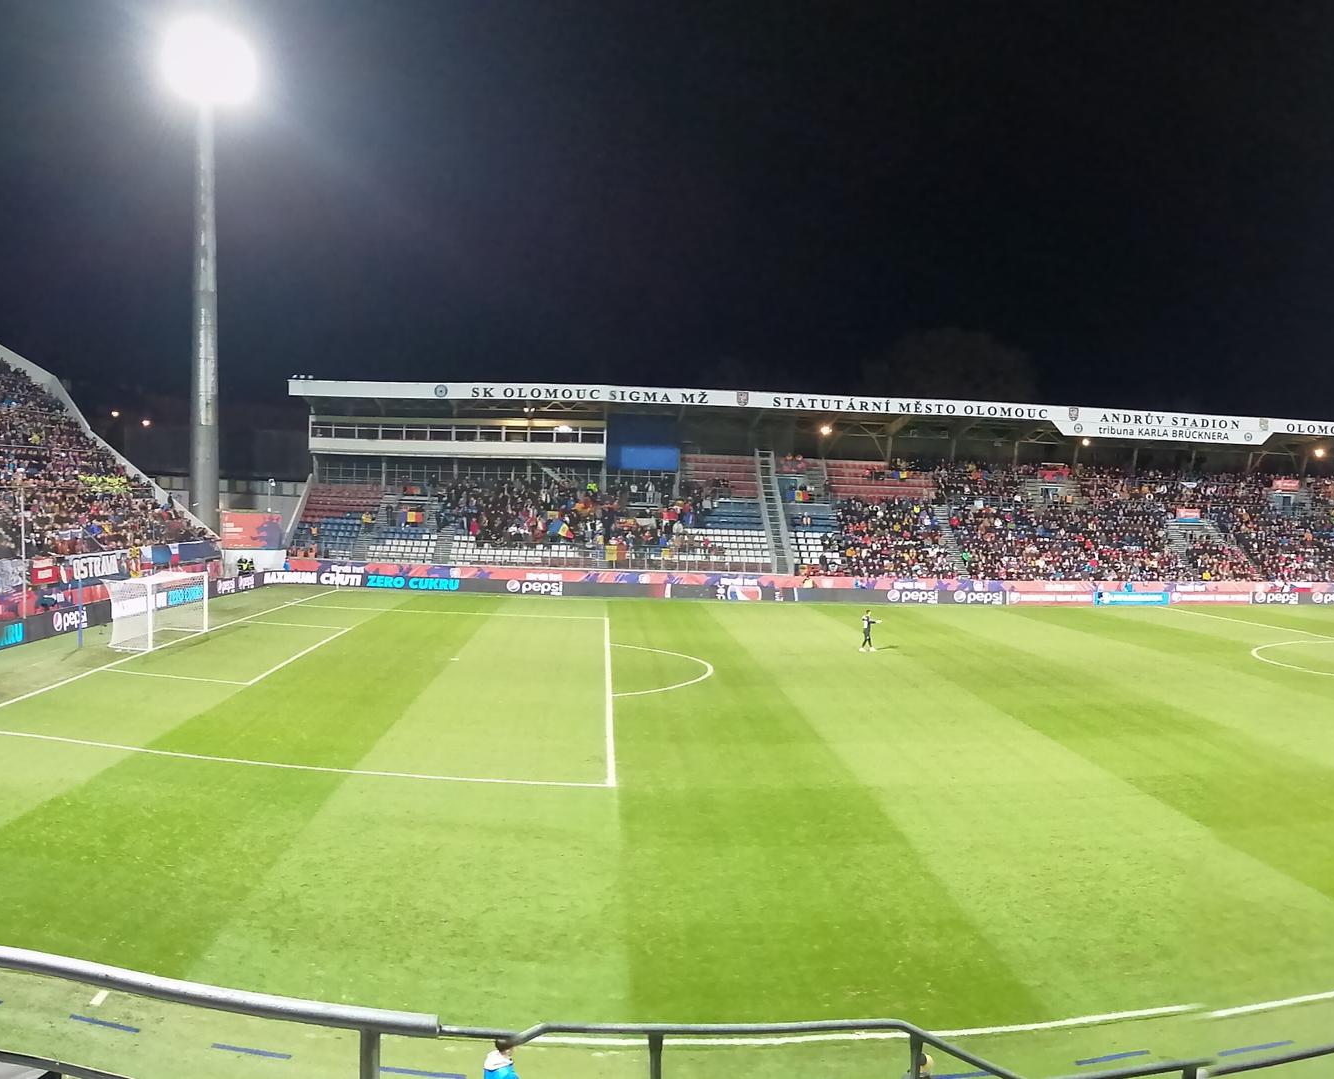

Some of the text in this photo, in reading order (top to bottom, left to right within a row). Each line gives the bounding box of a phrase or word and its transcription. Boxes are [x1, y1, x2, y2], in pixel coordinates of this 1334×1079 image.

[471, 387, 709, 404] SK OLOMOUC SIGMA MŽ
[772, 396, 1048, 419] STATUTÁRNÍ MĚSTO OLOMOUC
[1100, 413, 1240, 429] ANDRŮV STADION
[1099, 426, 1229, 441] tribuna KARLA BRÜCKNERA
[367, 576, 459, 591] ZERO CUKRU
[522, 581, 563, 595] pepsi
[902, 590, 938, 603] pepsi
[967, 591, 1003, 604] pepsi
[1267, 592, 1299, 604] pepsi
